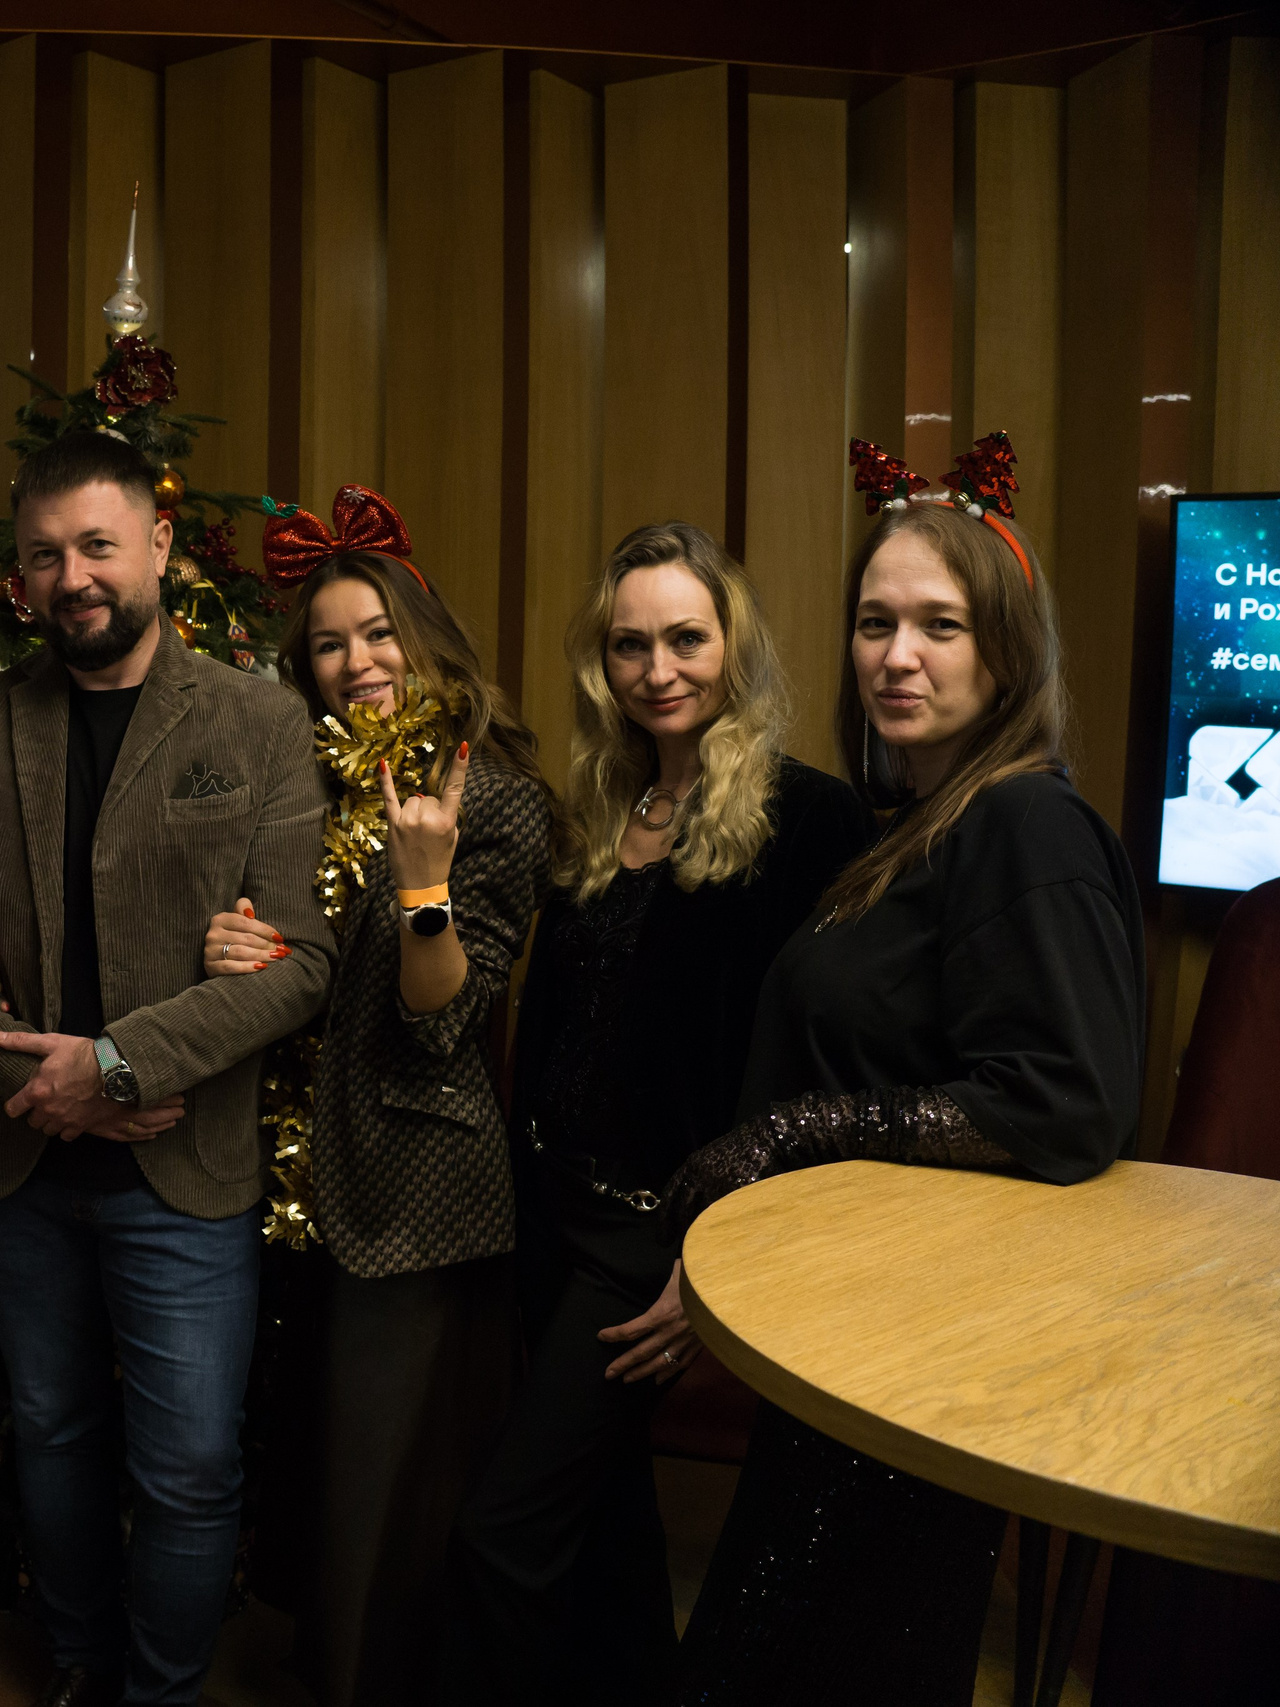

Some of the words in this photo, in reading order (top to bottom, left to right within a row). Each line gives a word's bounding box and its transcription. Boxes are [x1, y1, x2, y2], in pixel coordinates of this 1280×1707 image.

[1215, 563, 1237, 586] С
[1214, 603, 1231, 620] и
[1240, 598, 1280, 621] Ро
